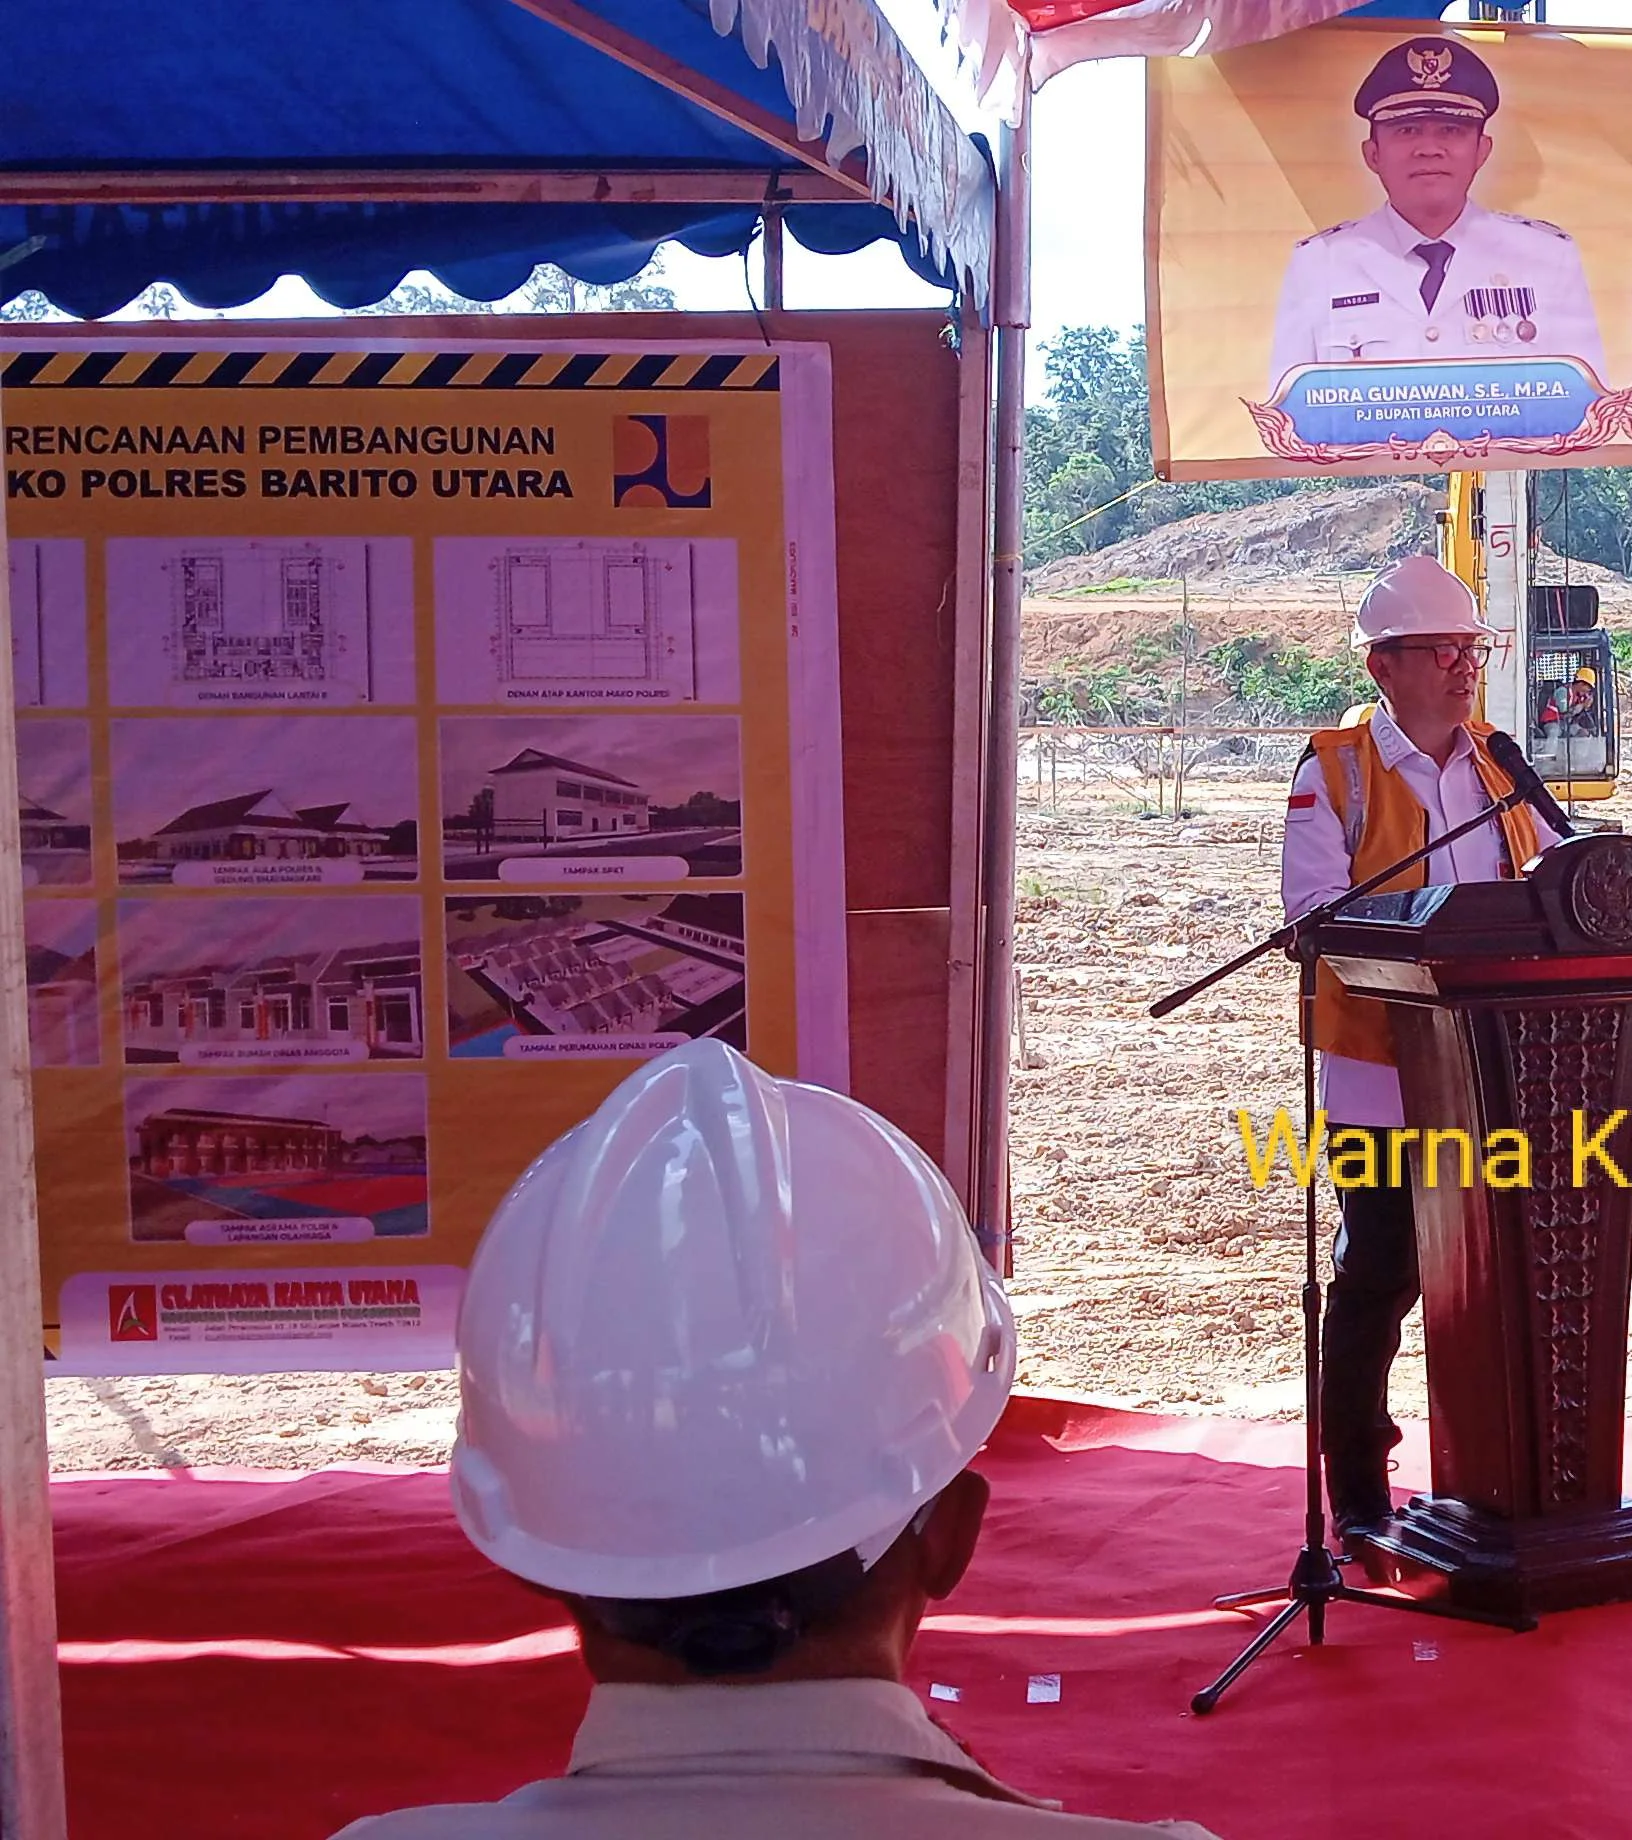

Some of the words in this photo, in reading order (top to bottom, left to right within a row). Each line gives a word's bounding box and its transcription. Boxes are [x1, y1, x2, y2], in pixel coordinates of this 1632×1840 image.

[1306, 387, 1363, 405] INDRA
[1367, 384, 1470, 402] GUNAWAN,
[1474, 382, 1509, 399] S.E.,
[1514, 381, 1570, 398] M.P.A.
[1356, 409, 1372, 422] PJ
[1375, 408, 1421, 421] BUPATI
[1424, 406, 1473, 420] BARITO
[1476, 404, 1521, 418] UTARA
[258, 425, 555, 455] PEMBANGUNAN
[81, 469, 248, 498] POLRES
[261, 469, 418, 498] BARITO
[432, 469, 575, 498] UTARA
[1489, 530, 1512, 558] 5
